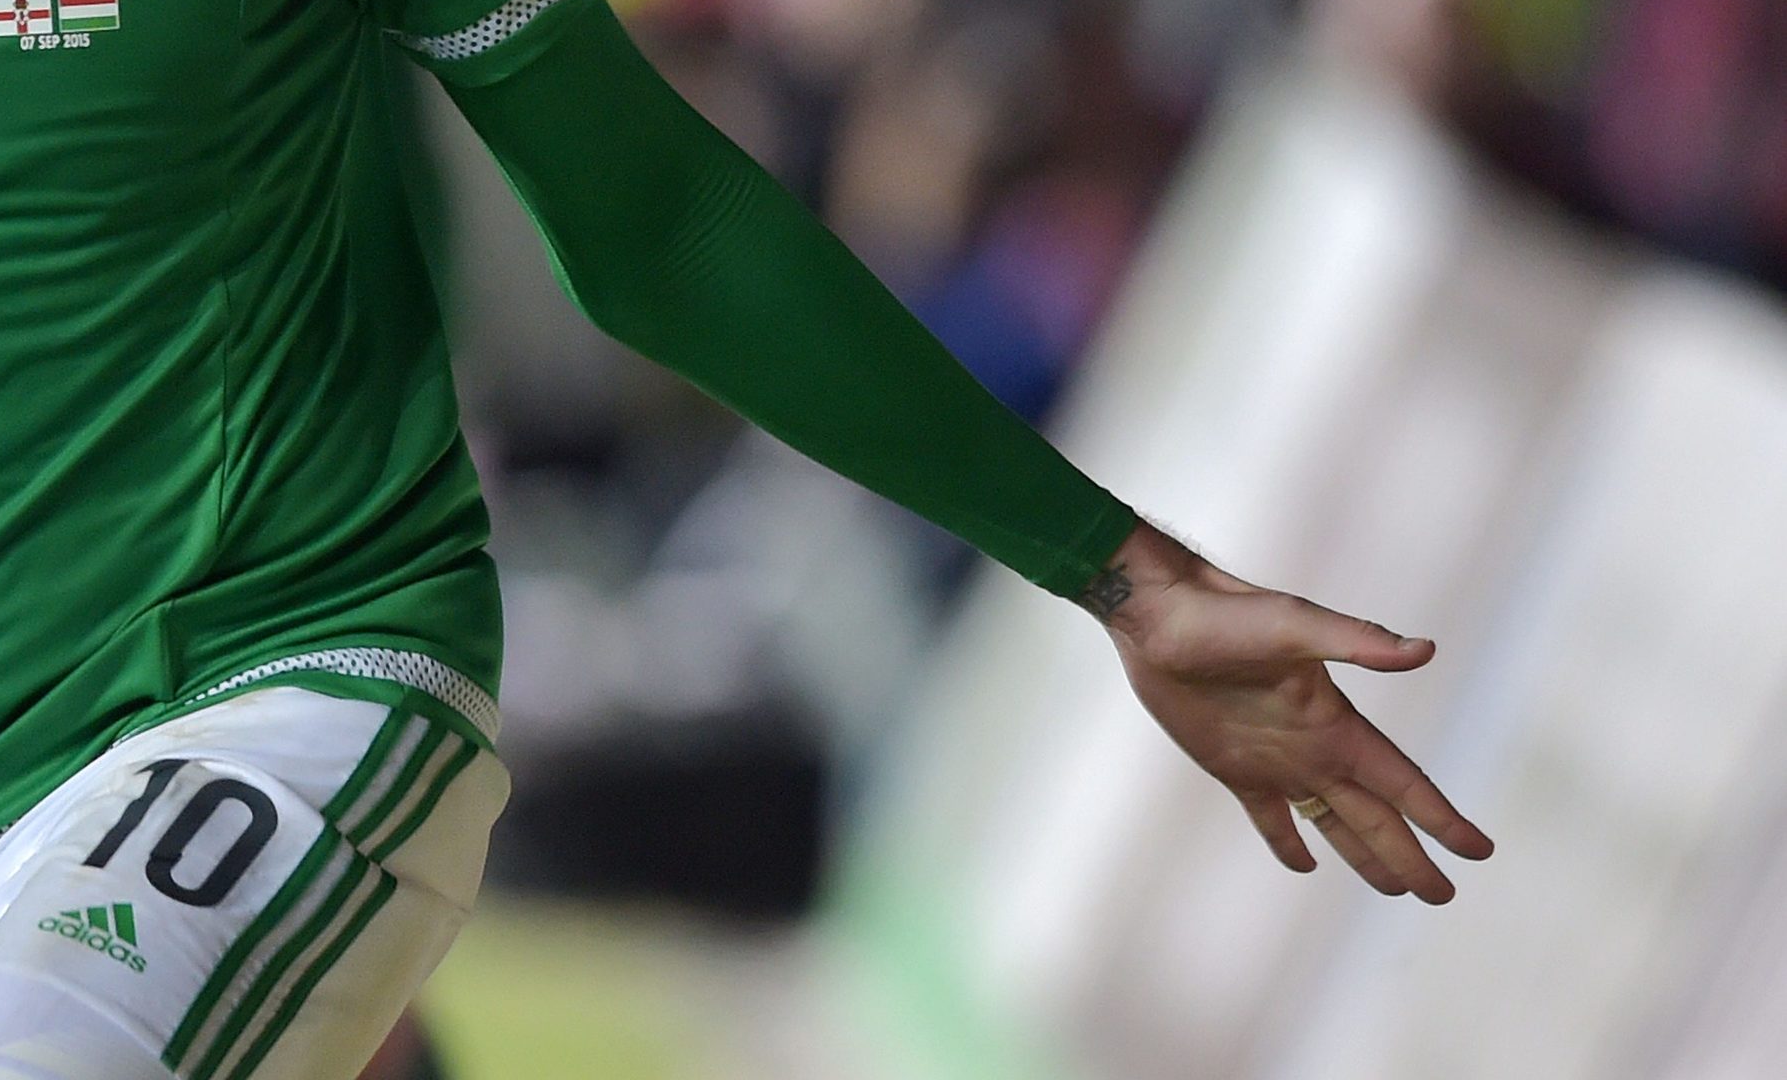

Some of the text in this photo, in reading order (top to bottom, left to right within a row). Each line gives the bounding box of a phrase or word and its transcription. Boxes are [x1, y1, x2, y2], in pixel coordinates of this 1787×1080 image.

[19, 33, 91, 51] 07 SEP 2015
[82, 758, 278, 908] 10
[38, 916, 148, 973] adidas
